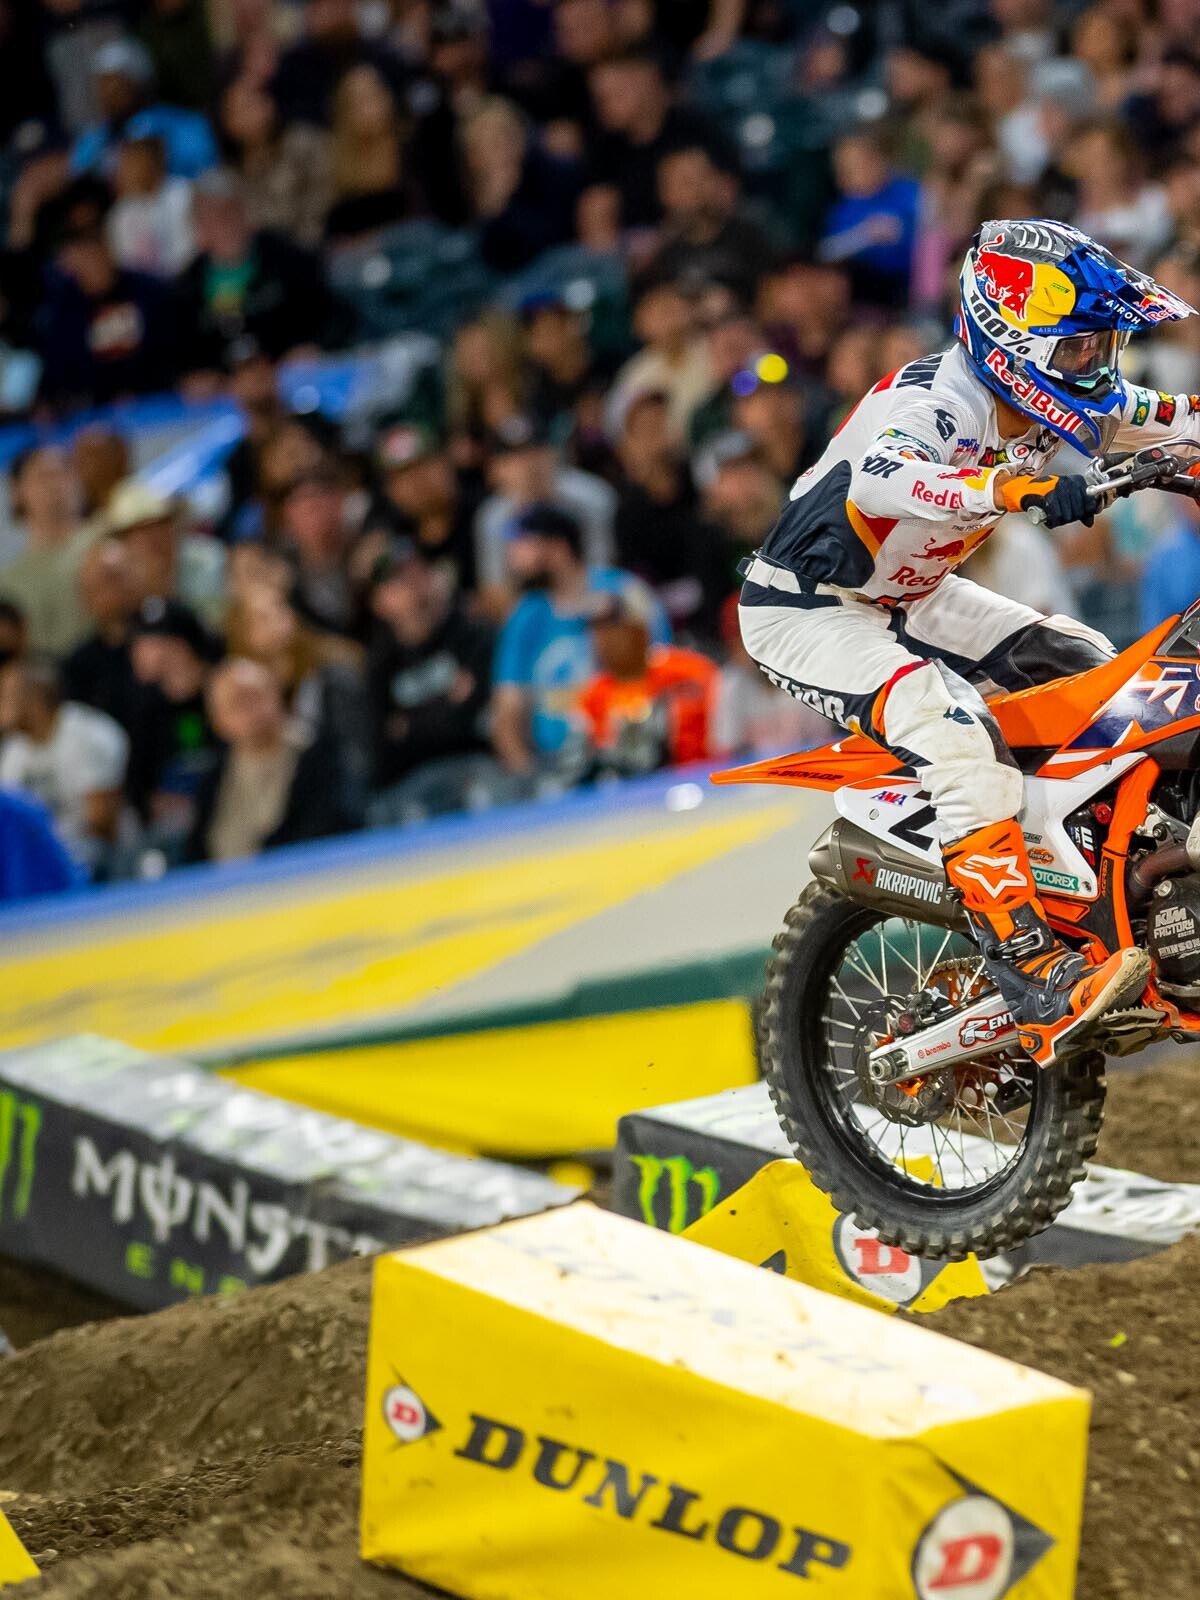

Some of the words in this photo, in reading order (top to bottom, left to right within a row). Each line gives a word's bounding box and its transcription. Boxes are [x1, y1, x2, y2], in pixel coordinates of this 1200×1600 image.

[971, 290, 1031, 355] 100%
[1105, 299, 1142, 325] AIROH
[888, 566, 949, 587] Red
[779, 770, 844, 781] DUNLOP
[870, 791, 908, 806] AMA
[875, 867, 944, 905] AKRAPOVIČ
[1154, 918, 1195, 939] FACTORY
[1155, 906, 1187, 929] KTM
[925, 1041, 951, 1057] brembo
[454, 1413, 853, 1579] DUNLOP
